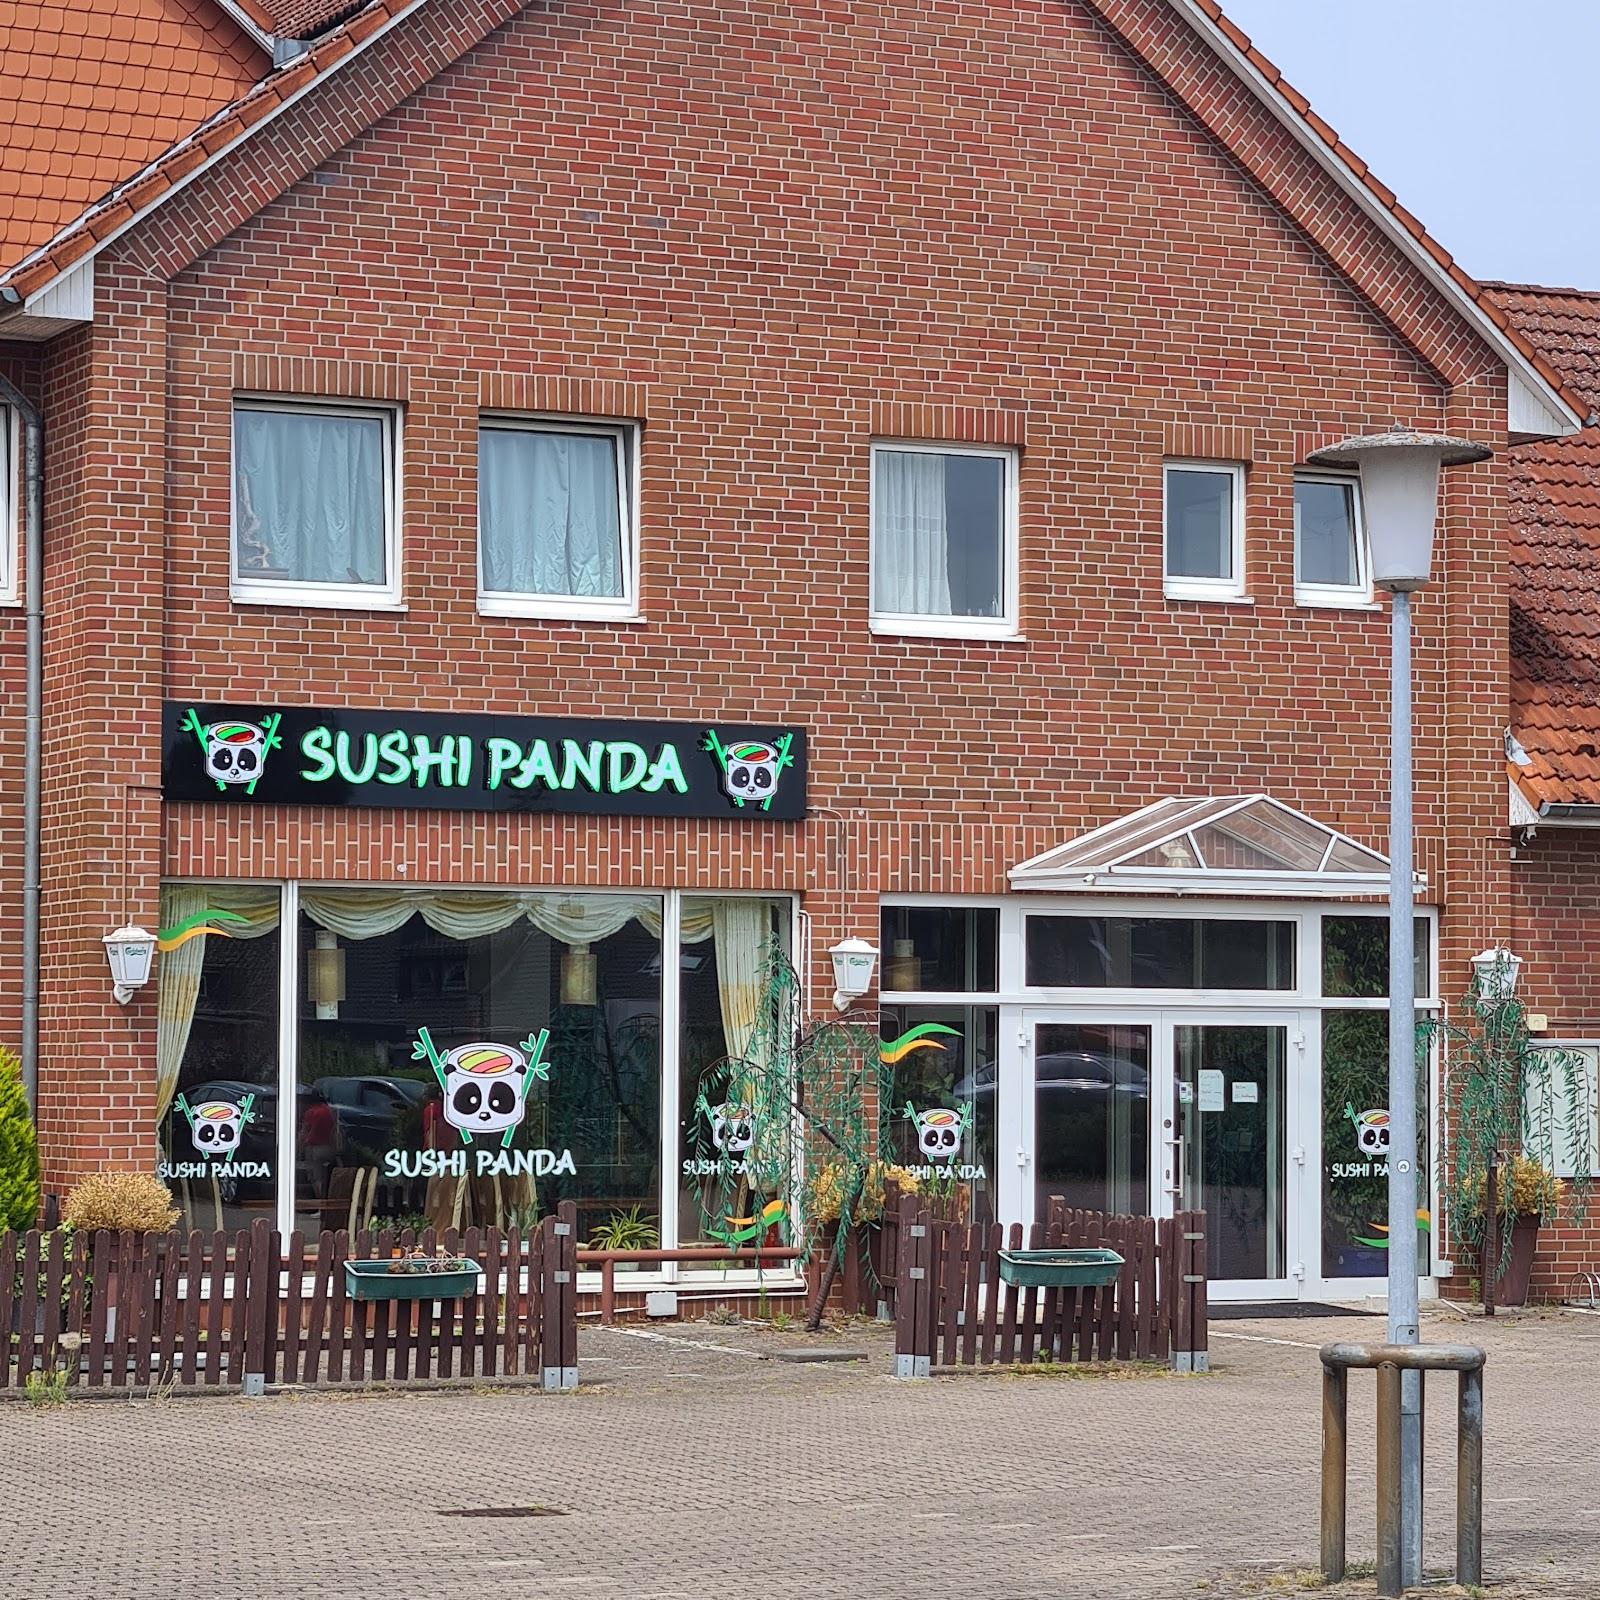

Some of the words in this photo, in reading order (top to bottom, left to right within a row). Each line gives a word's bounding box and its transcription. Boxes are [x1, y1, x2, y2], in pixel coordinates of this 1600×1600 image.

[301, 726, 472, 788] SUSHI
[487, 737, 689, 794] PANDA
[158, 1161, 206, 1178] SUSHI
[211, 1161, 271, 1178] PANDA
[385, 1149, 466, 1178] SUSHI
[476, 1149, 577, 1178] PANDA
[935, 1164, 987, 1179] PANDA
[1332, 1163, 1370, 1177] SUSHI
